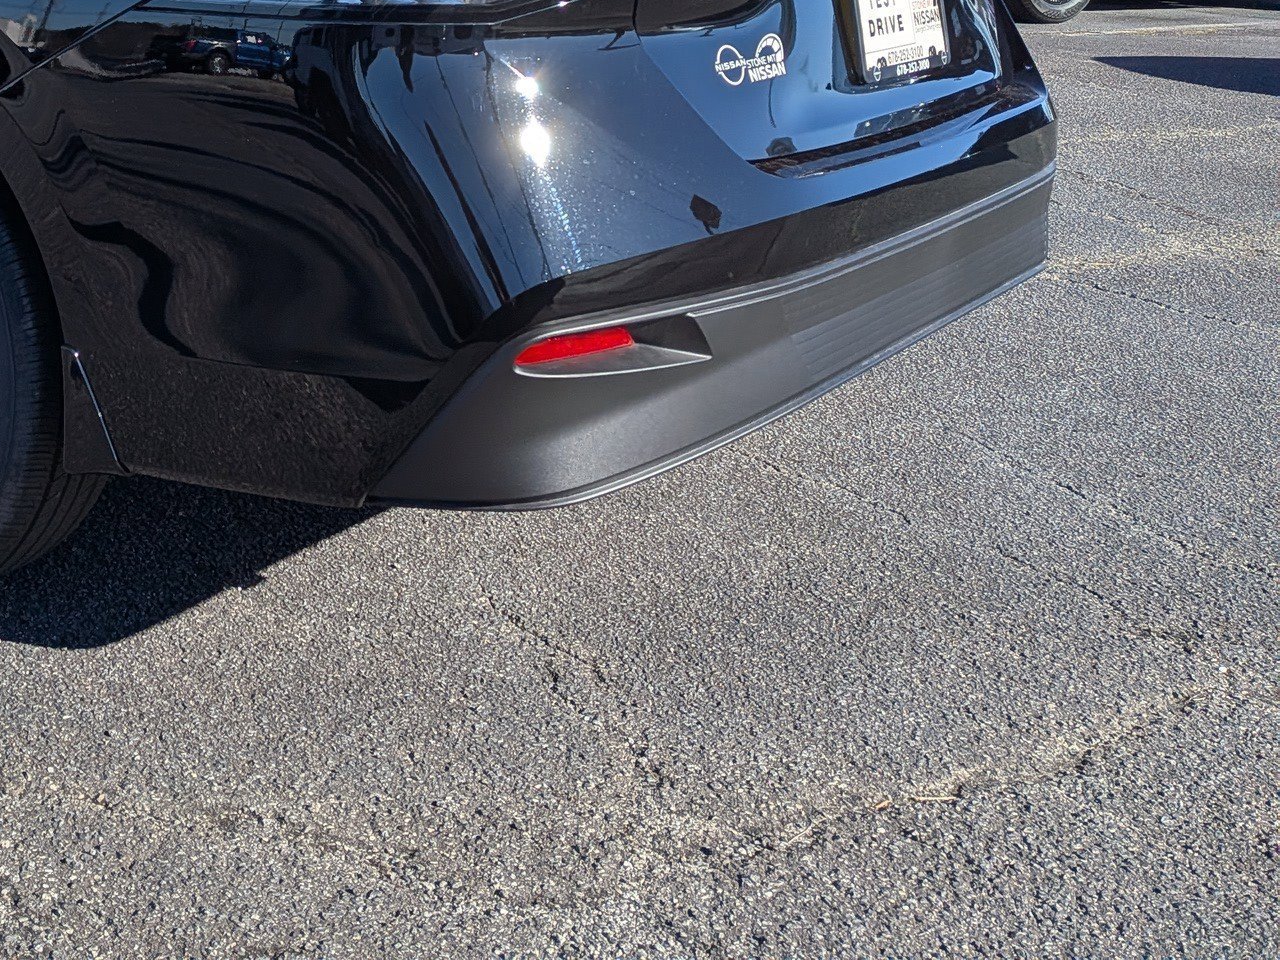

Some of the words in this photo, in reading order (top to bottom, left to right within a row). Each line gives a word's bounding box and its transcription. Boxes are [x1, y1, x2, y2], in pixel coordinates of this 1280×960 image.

[868, 14, 905, 38] DRIVE
[913, 9, 941, 27] NISSAN
[715, 59, 746, 72] NISSAN
[746, 57, 766, 69] STONE
[767, 53, 776, 64] MT
[748, 61, 787, 83] NISSAN
